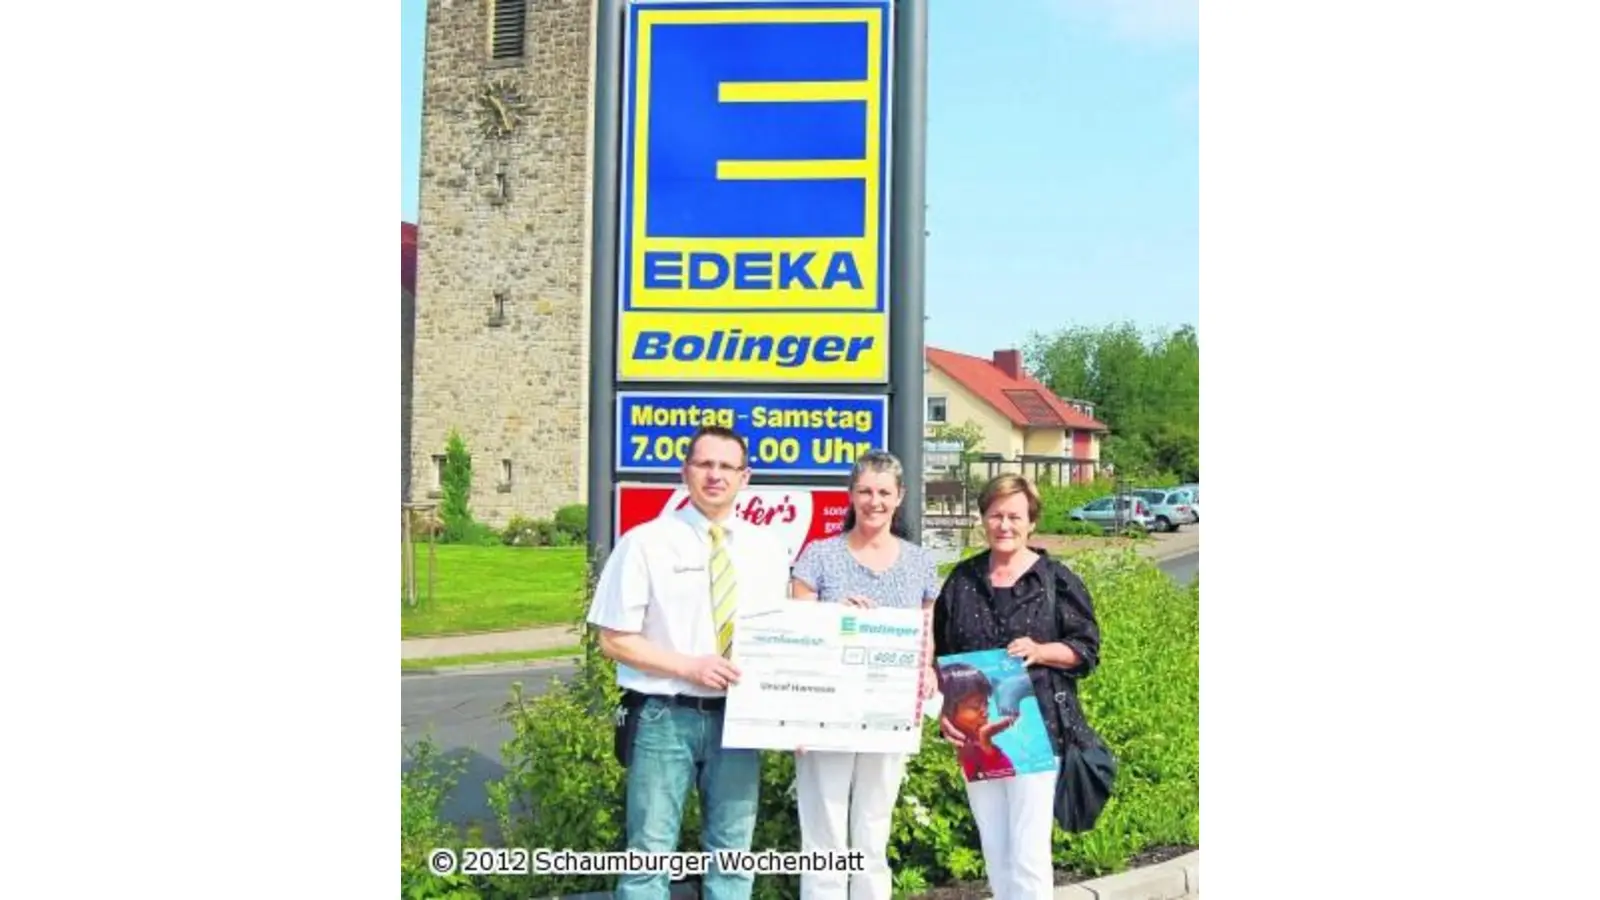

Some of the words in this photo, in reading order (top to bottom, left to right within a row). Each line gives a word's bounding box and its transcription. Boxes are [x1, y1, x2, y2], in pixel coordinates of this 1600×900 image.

[646, 21, 869, 237] E
[643, 251, 864, 290] EDEKA
[632, 329, 875, 367] Bolinger
[812, 437, 871, 463] Uhr
